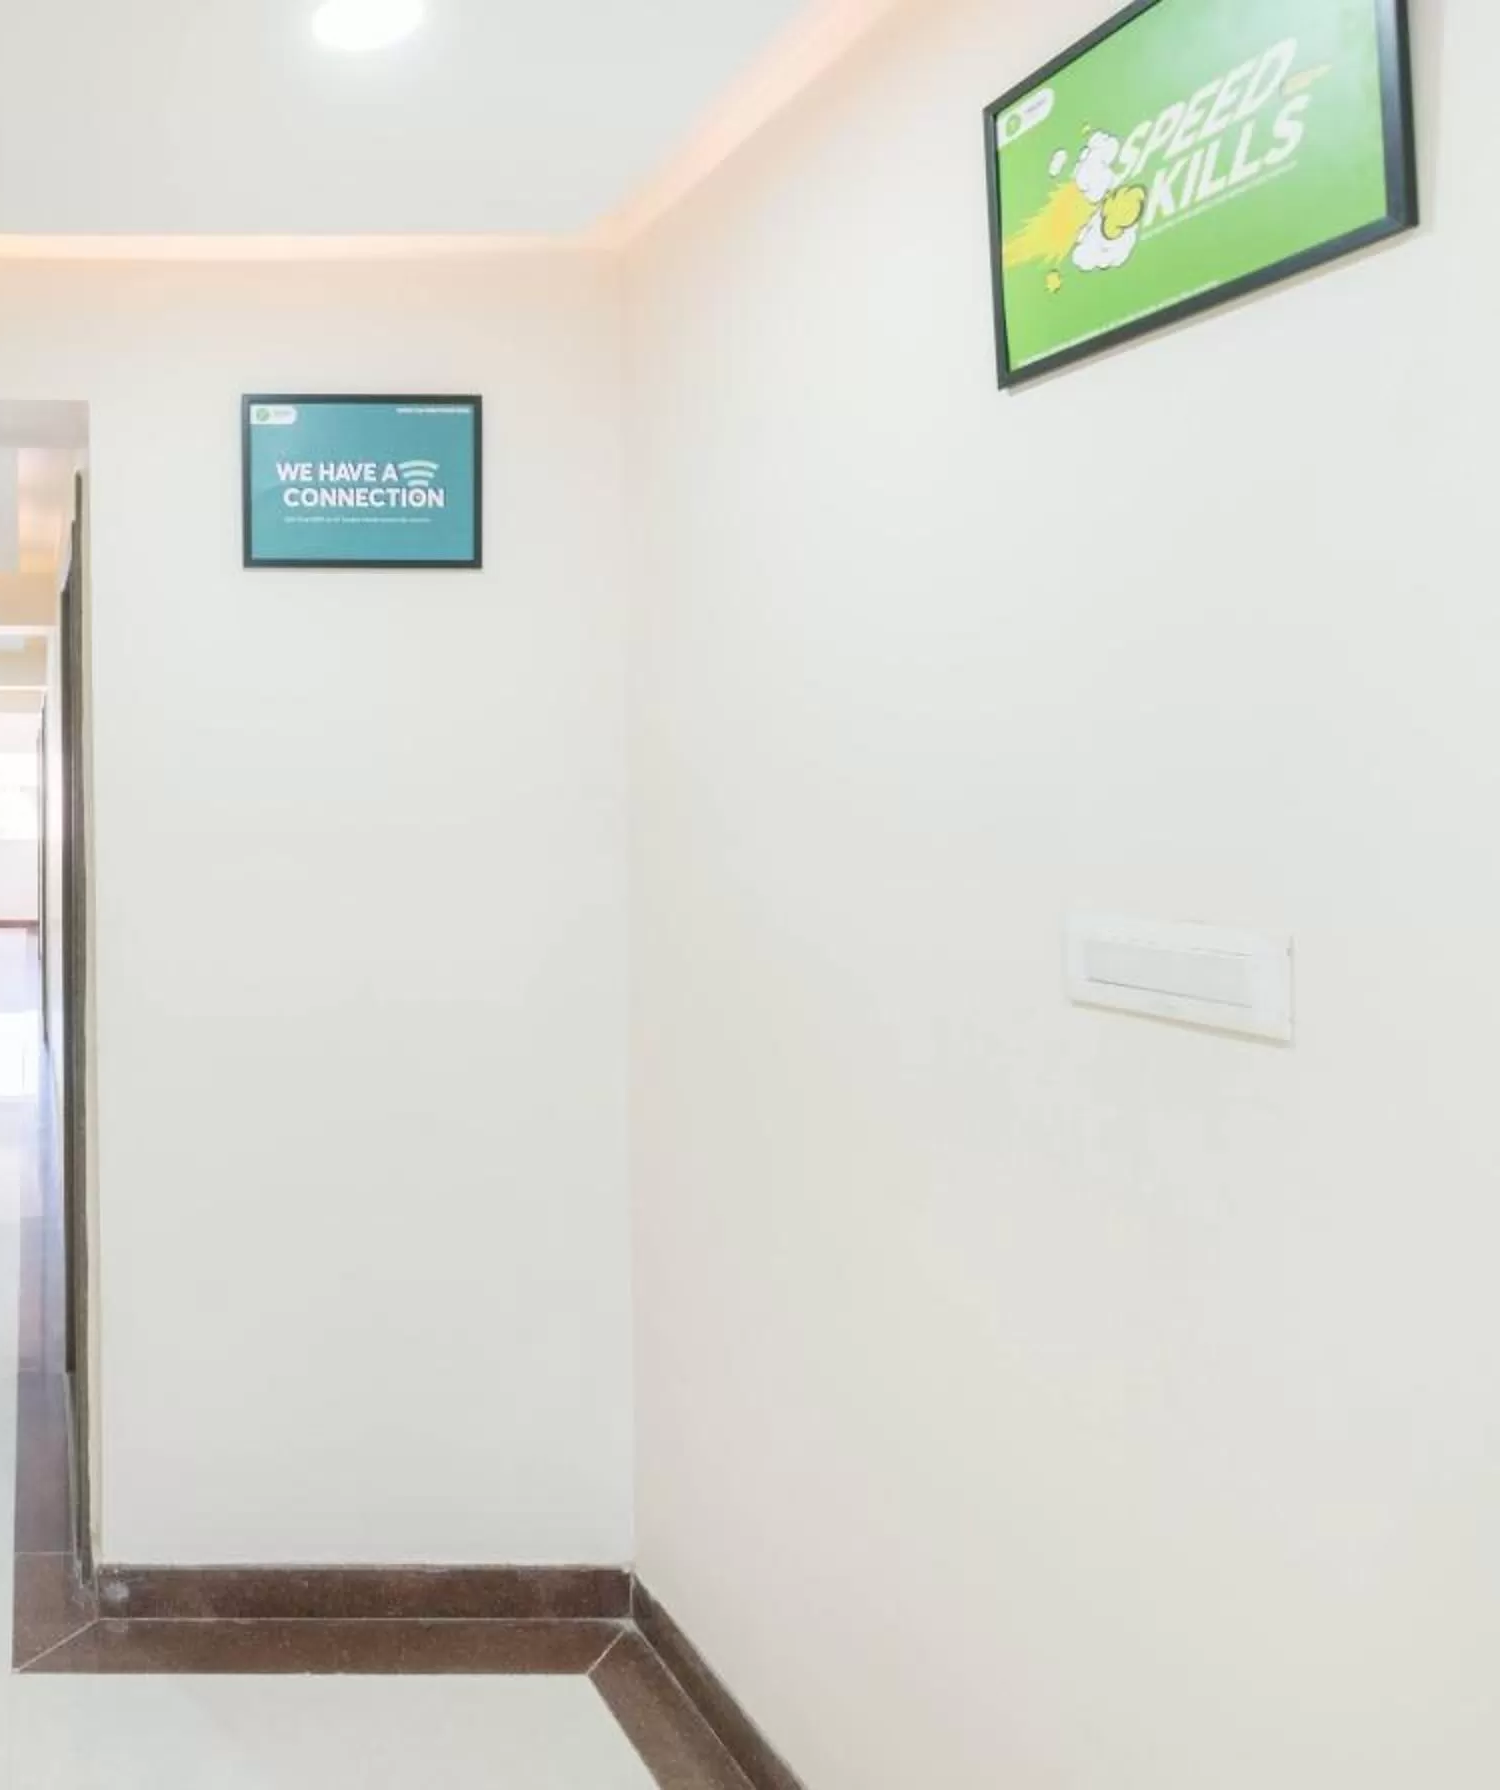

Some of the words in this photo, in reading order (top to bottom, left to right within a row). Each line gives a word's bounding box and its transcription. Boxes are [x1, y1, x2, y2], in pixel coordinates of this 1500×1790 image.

[1114, 36, 1298, 185] SPEED
[1143, 93, 1311, 227] KILLS
[276, 461, 313, 482] WE
[318, 461, 377, 482] HAVE
[381, 461, 400, 482] A
[282, 487, 446, 508] CONNECTION
